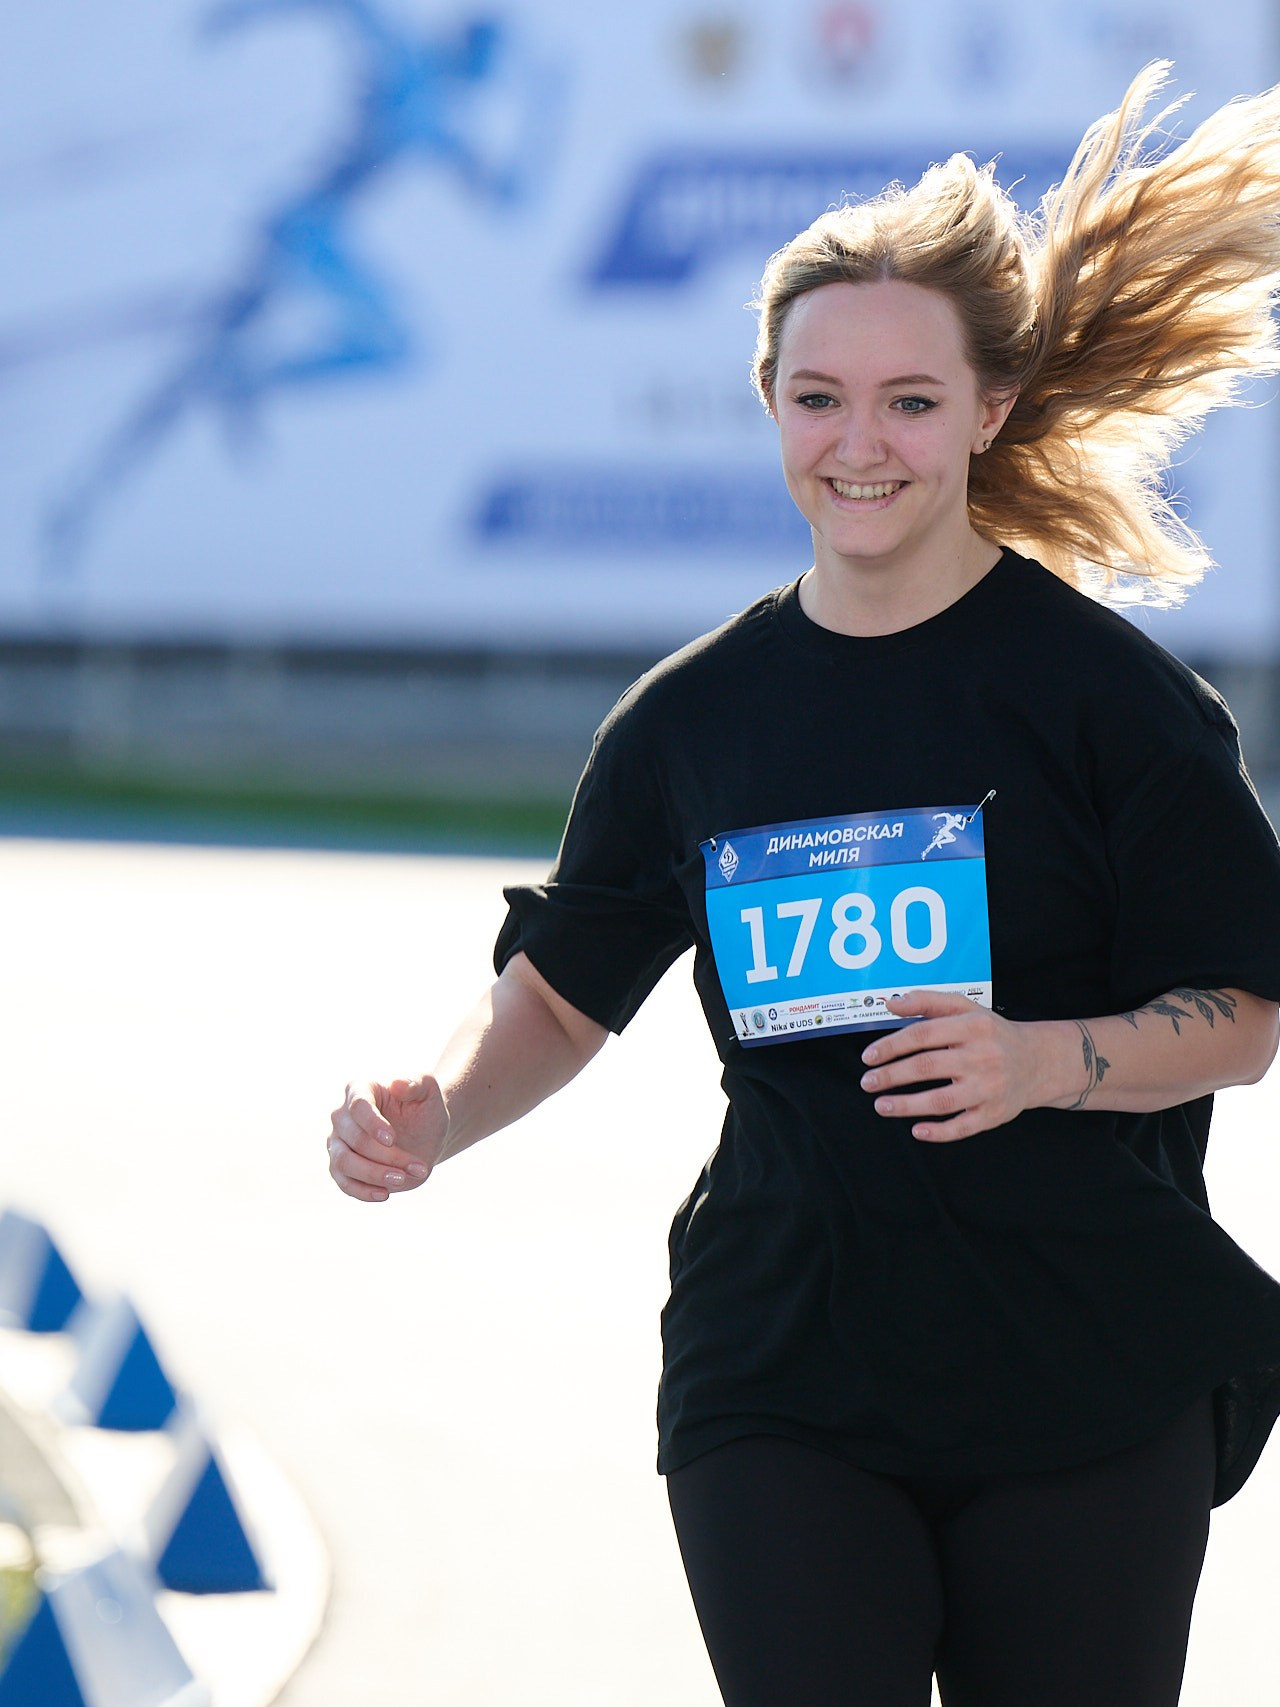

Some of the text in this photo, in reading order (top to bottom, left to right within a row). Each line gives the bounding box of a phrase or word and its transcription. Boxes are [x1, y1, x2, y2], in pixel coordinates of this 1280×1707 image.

[766, 822, 904, 856] ДИНАМОВСКАЯ
[808, 846, 860, 868] МИЛЯ
[740, 886, 948, 985] 1780
[789, 1003, 820, 1014] РОНДАМИТ
[796, 1018, 814, 1028] UDS
